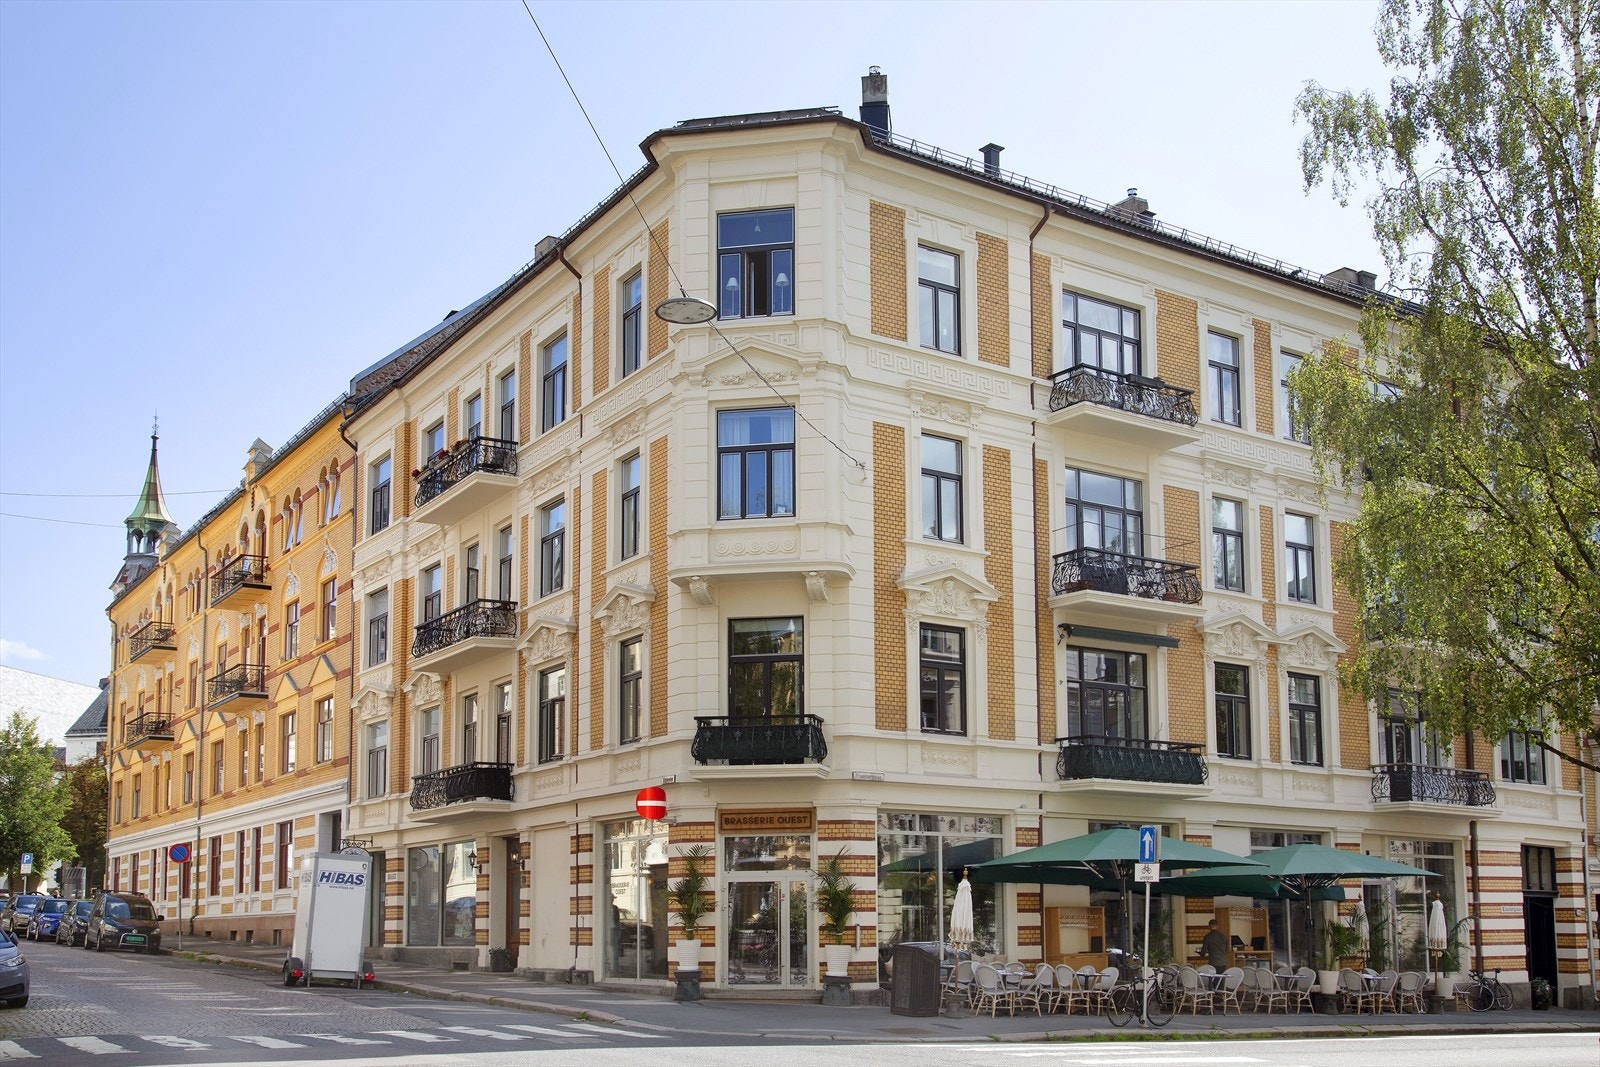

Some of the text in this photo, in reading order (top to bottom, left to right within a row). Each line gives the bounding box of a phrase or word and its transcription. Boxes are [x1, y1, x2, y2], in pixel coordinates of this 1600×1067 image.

[724, 815, 808, 825] BRASSERIE OUEST
[23, 854, 31, 863] P
